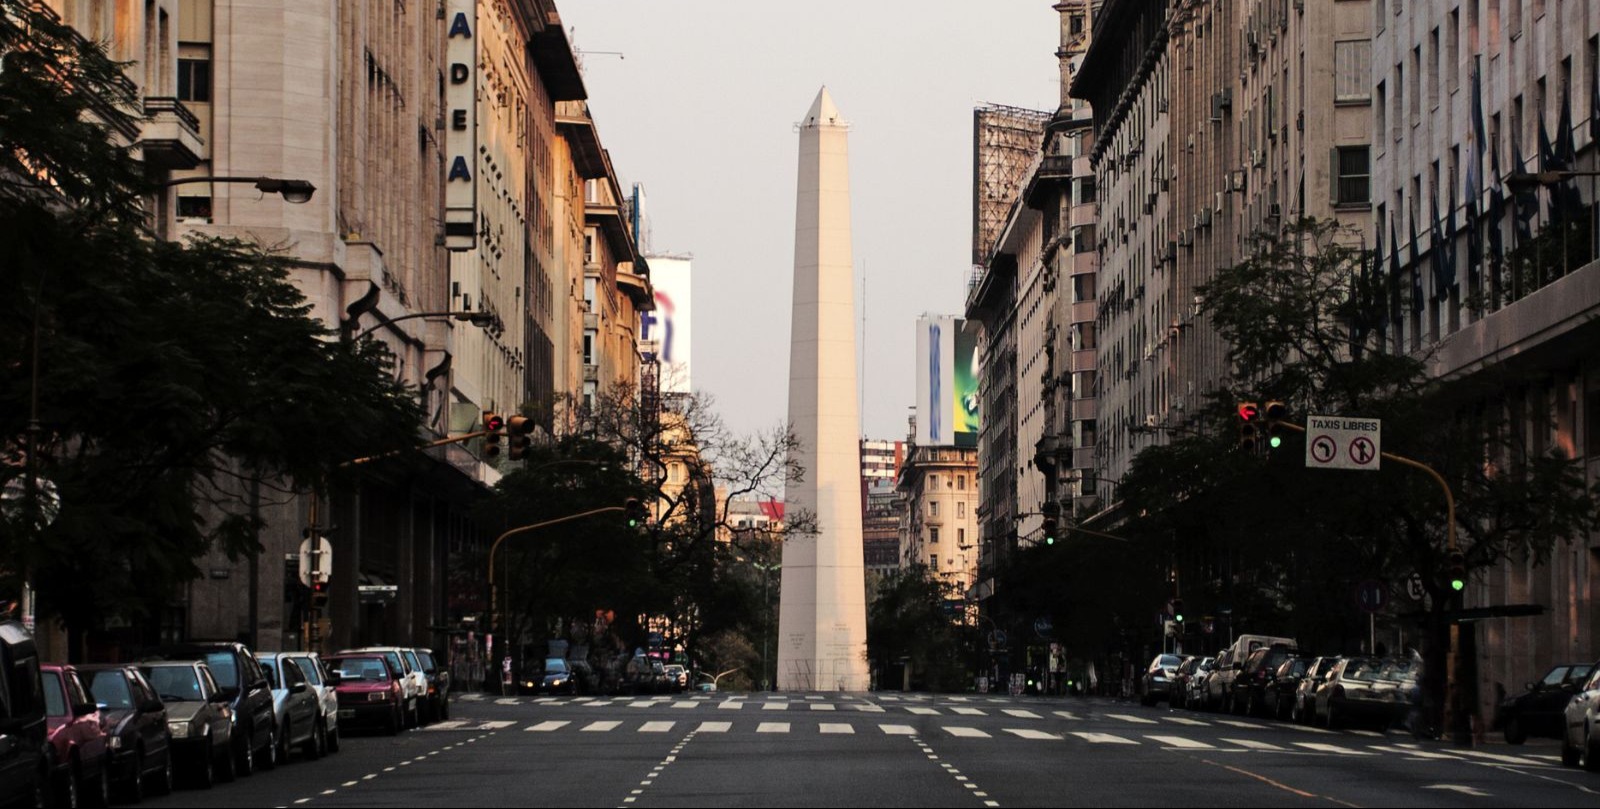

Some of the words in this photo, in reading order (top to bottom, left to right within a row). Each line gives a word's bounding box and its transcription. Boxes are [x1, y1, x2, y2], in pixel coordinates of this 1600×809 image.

[448, 12, 472, 182] ADEA
[1311, 419, 1340, 430] TAXIS
[1343, 421, 1378, 431] LIBRES
